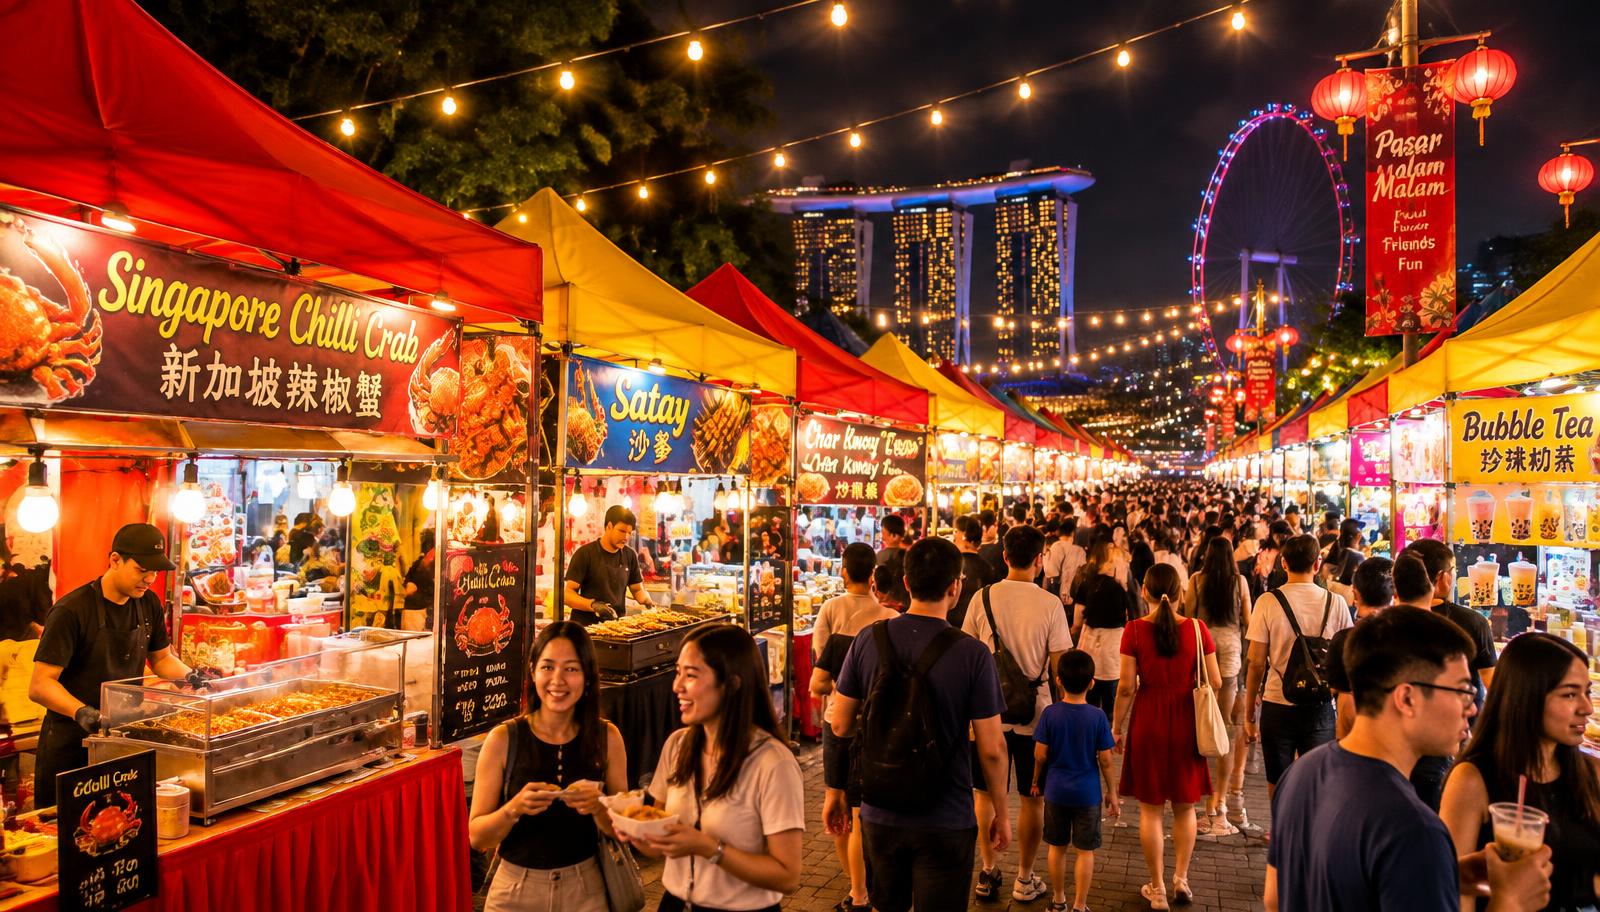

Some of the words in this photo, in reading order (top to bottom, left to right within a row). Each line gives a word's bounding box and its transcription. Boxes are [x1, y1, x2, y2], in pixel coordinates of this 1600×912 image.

[1398, 257, 1423, 271] Fun
[98, 250, 280, 345] Singapore
[289, 293, 361, 355] Chilli
[364, 311, 420, 364] Crab
[159, 342, 382, 419] 新加坡辣椒蟹
[610, 373, 691, 438] Satay
[1462, 408, 1545, 442] Bubble
[1552, 406, 1594, 440] Tea
